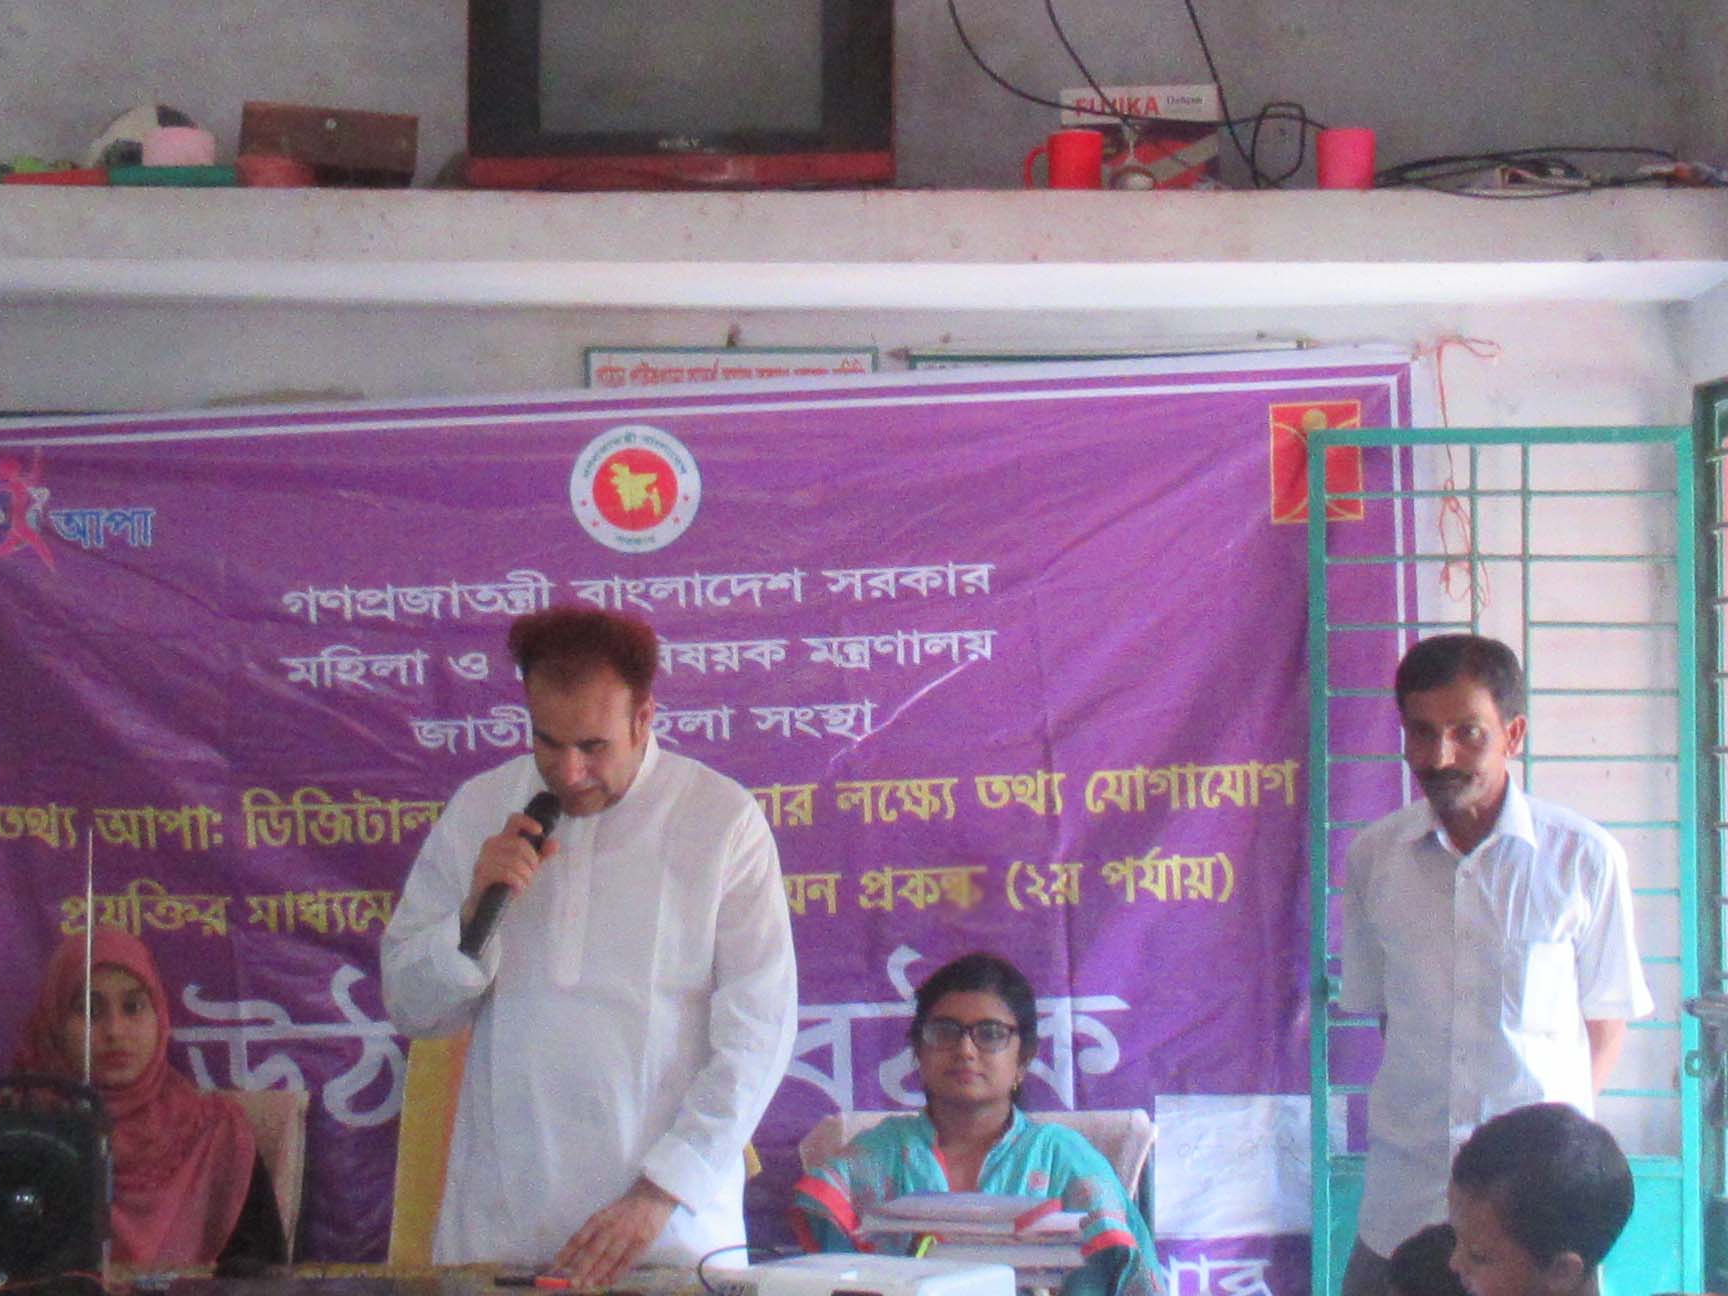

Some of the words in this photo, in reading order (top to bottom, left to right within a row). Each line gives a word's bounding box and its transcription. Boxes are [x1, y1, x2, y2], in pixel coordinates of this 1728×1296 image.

[48, 507, 157, 549] আপা
[282, 569, 556, 623] গণপ্রজাতন্ত্রী
[571, 567, 806, 611] বাংলাদেশ
[822, 561, 996, 601] সরকার
[279, 644, 429, 689] মহিলা
[448, 652, 489, 681] ও
[801, 629, 997, 671] মন্ত্রণালয়
[410, 704, 533, 753] জাতী
[750, 700, 878, 741] সংস্থা
[241, 787, 446, 848] ডিজিটাল
[835, 777, 959, 824] লক্ষ্যে
[975, 769, 1066, 815] তথ্য
[1085, 759, 1301, 812] যোগাযোগ
[61, 878, 232, 936] প্রযক্তির
[168, 963, 409, 1128] উঠ
